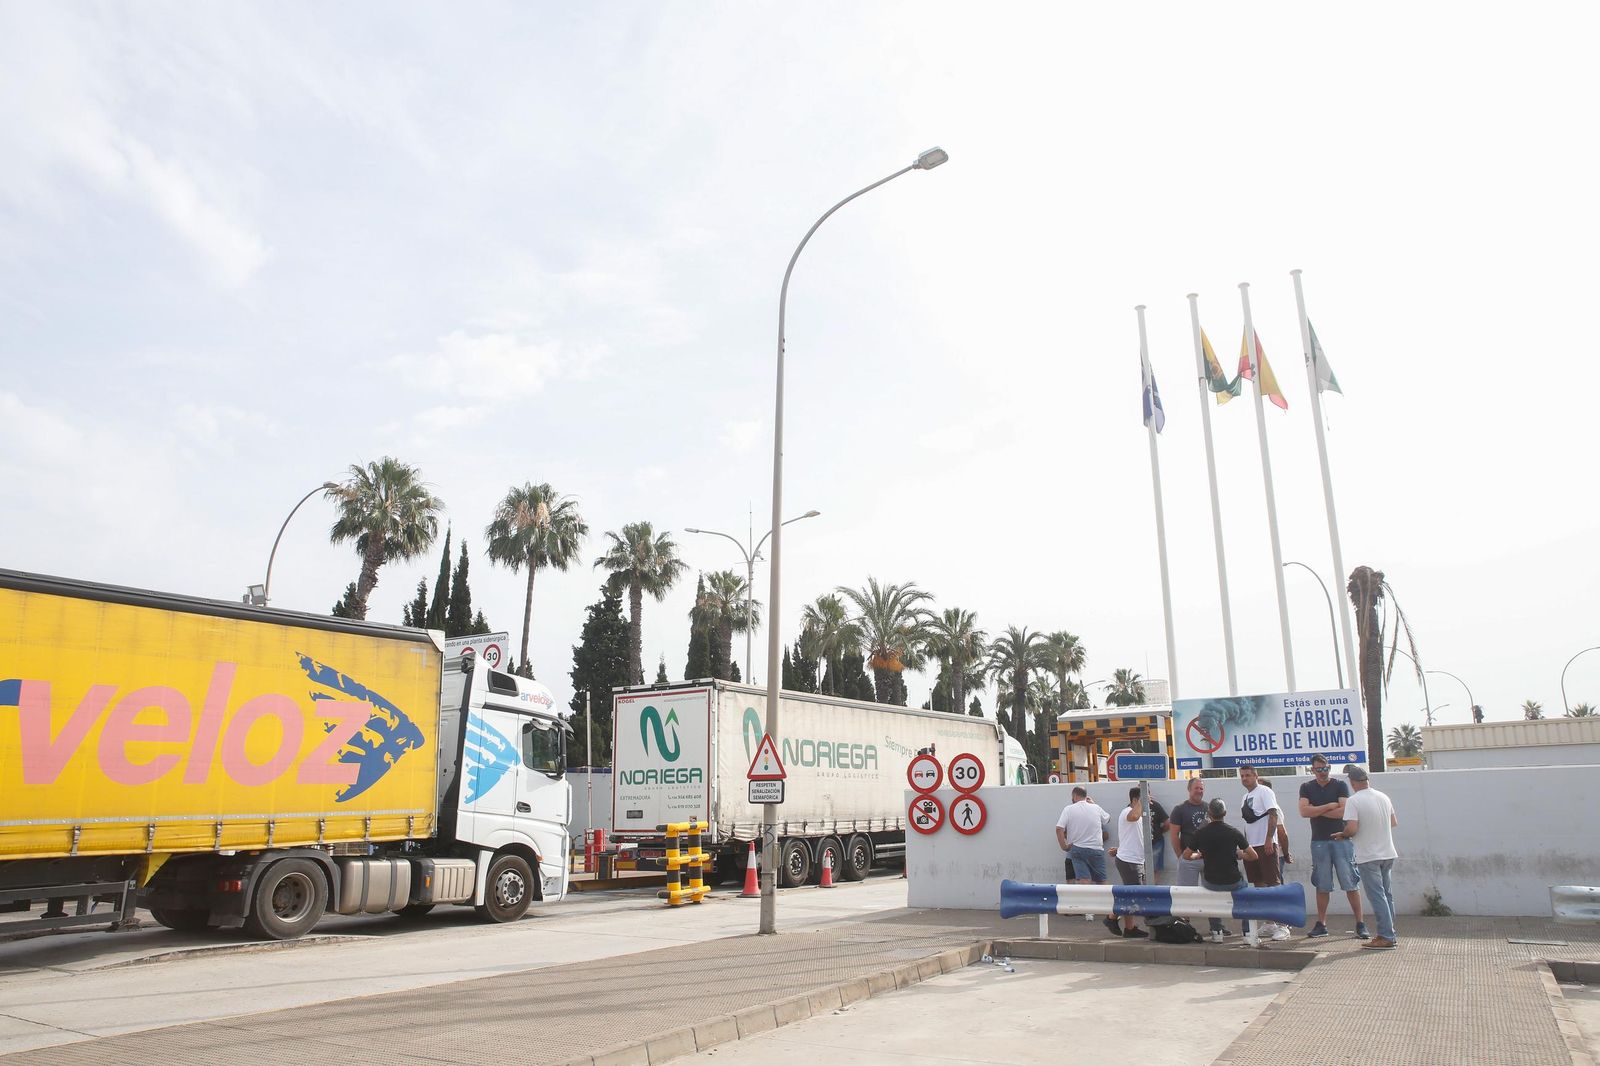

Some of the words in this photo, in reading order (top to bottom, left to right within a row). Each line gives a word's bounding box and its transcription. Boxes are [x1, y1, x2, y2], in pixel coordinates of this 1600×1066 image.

[487, 652, 498, 661] 30
[1283, 698, 1311, 708] Estás
[1329, 697, 1349, 705] una
[1284, 708, 1353, 729] FÁBRICA
[884, 735, 913, 758] Siempre
[1233, 733, 1278, 752] LIBRE
[1283, 732, 1303, 750] DE
[1307, 729, 1355, 749] HUMO
[782, 738, 879, 770] NORIEGA
[1235, 757, 1266, 765] Prohibido
[619, 767, 703, 786] NORIEGA
[955, 766, 978, 780] 30
